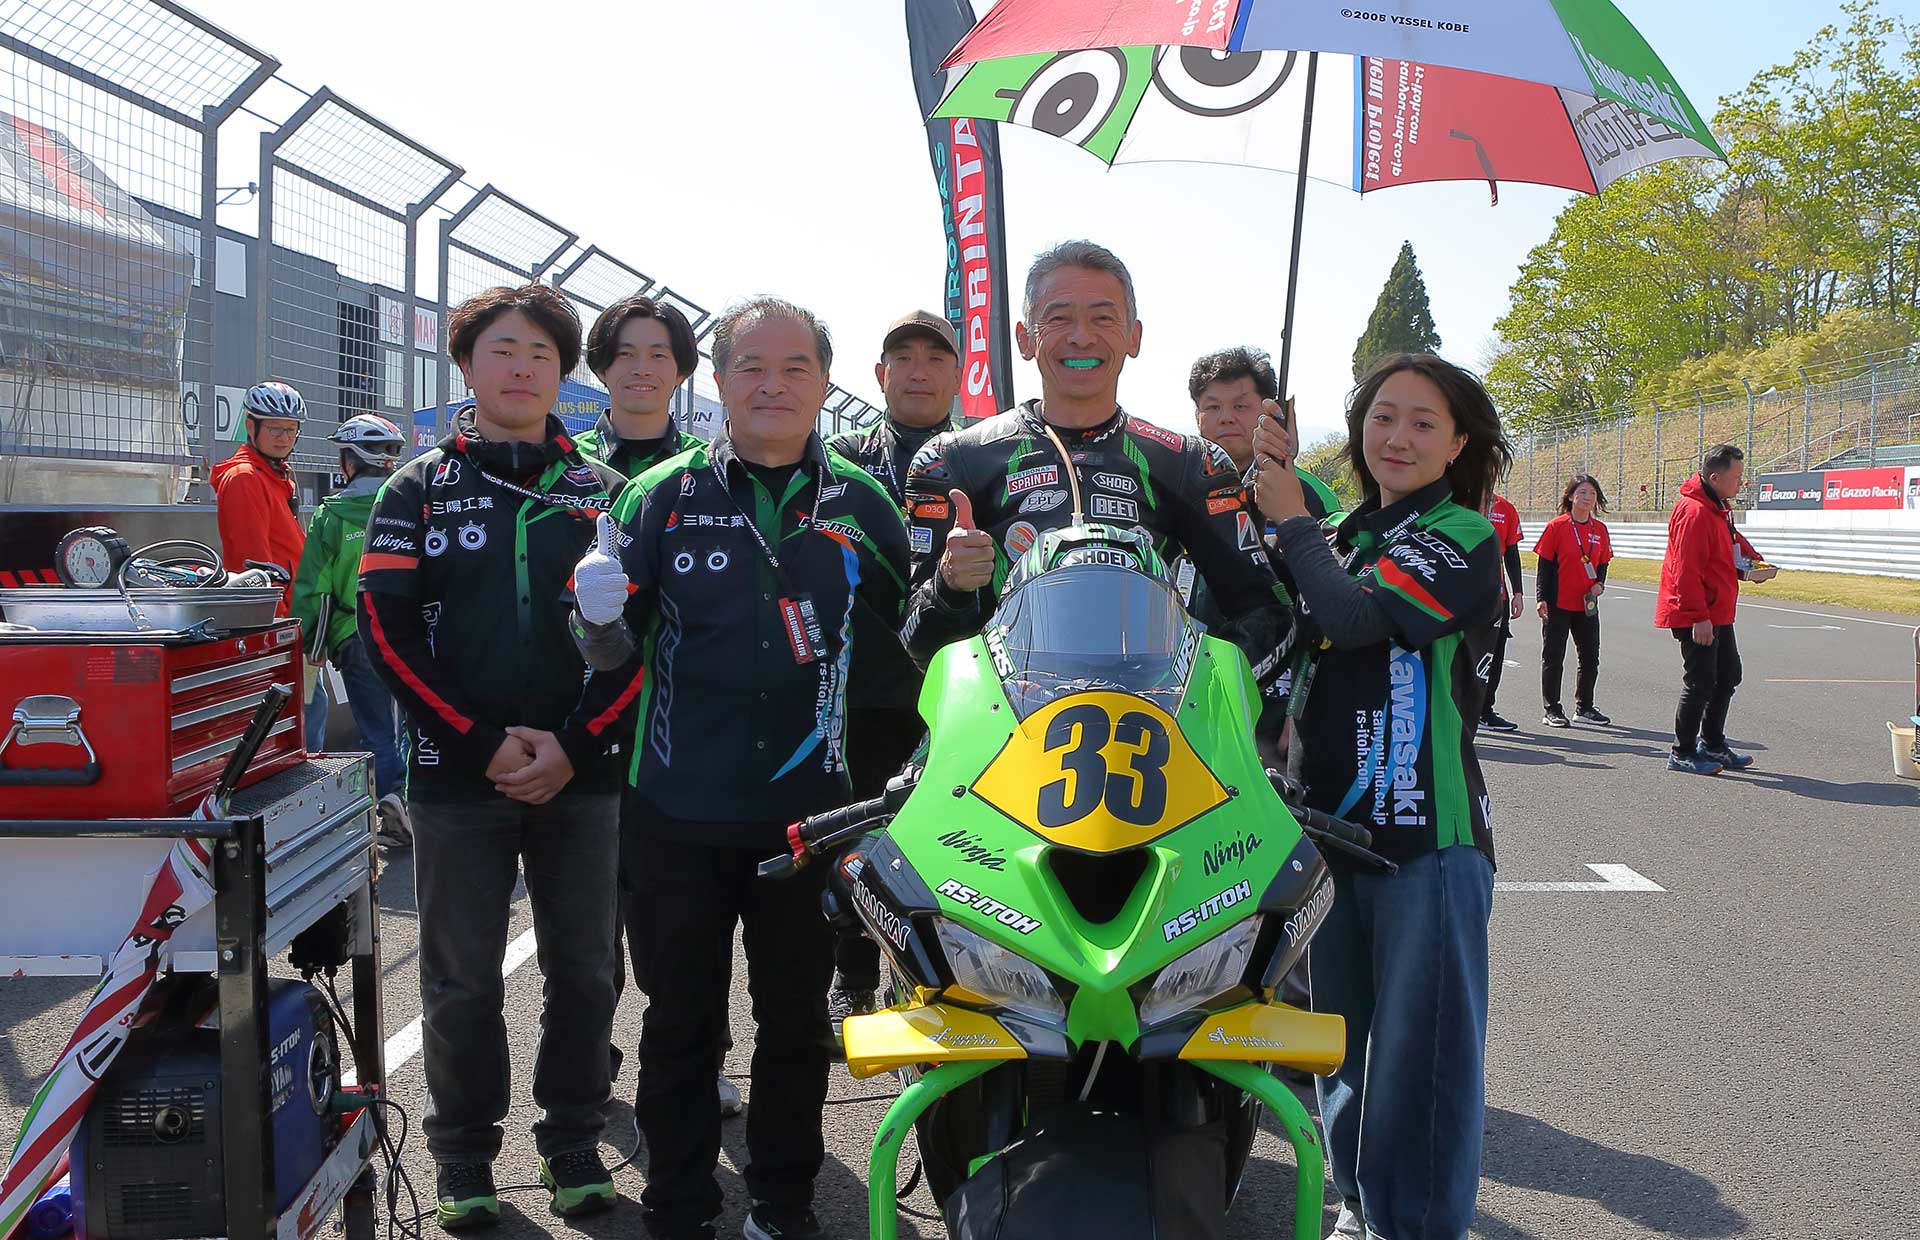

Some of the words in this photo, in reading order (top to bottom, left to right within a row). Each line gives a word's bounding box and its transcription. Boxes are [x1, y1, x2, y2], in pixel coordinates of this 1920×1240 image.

[1341, 9, 1387, 22] ©2005
[1390, 15, 1433, 29] VISSEL
[1437, 21, 1470, 33] KOBE
[953, 117, 993, 397] SPRINTA
[1011, 473, 1054, 491] SPRINTA
[1099, 477, 1132, 491] SHOEI
[1759, 490, 1772, 502] GR
[1797, 489, 1822, 502] Racing
[1826, 487, 1840, 499] GR
[433, 497, 494, 515] 三陽工業
[683, 514, 745, 528] 三陽工業
[1095, 498, 1135, 517] BEET
[1382, 510, 1420, 539] Kawasaki
[372, 532, 417, 551] Ninja
[1068, 551, 1128, 567] SHOEI
[1388, 544, 1437, 582] Ninja
[985, 628, 1014, 677] WRS
[1174, 630, 1197, 687] WRS
[1037, 704, 1171, 828] 33
[1356, 710, 1370, 790] rs-itoh.com
[1371, 710, 1386, 826] sanyou-ind.co.jp
[937, 830, 1008, 872] Ninja
[1203, 831, 1263, 877] Ninja
[936, 878, 1043, 935] RS-ITOH
[1162, 879, 1252, 943] RS-ITOH
